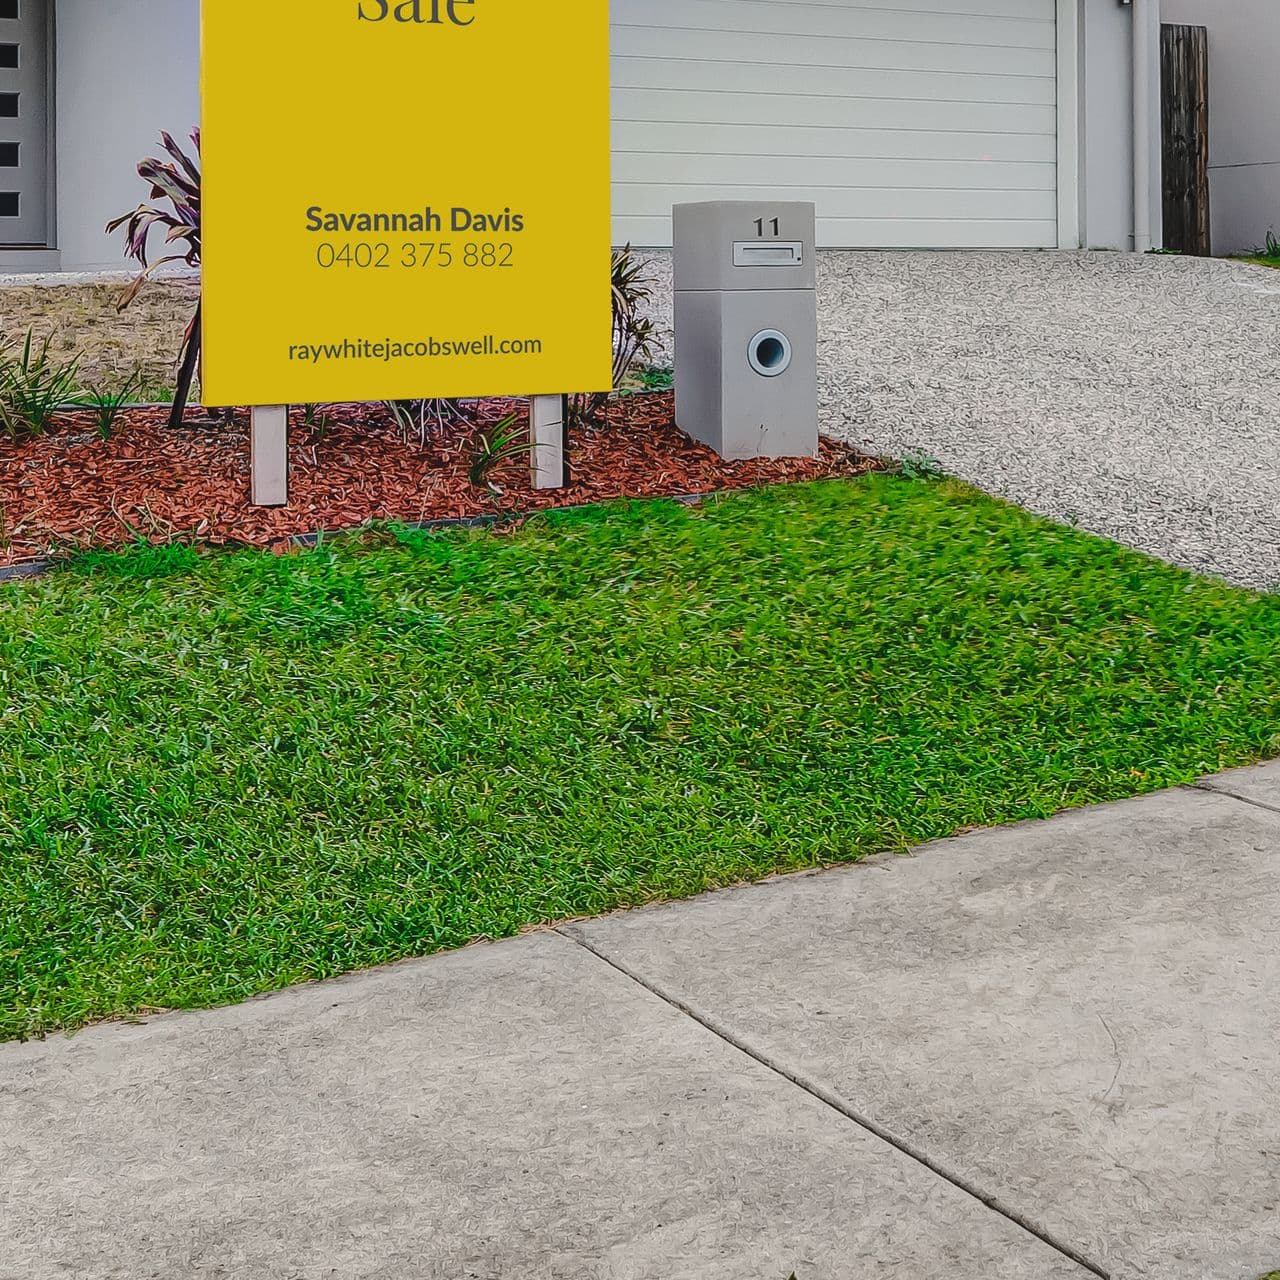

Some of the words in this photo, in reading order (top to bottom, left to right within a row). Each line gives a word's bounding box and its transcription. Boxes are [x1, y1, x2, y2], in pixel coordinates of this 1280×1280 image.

[305, 206, 442, 233] Savannah
[450, 206, 525, 233] Davis
[753, 216, 779, 237] 11
[316, 242, 390, 268] 0402
[400, 242, 452, 268] 375
[463, 242, 513, 268] 882
[288, 334, 542, 364] raywhitejacobswell.com
